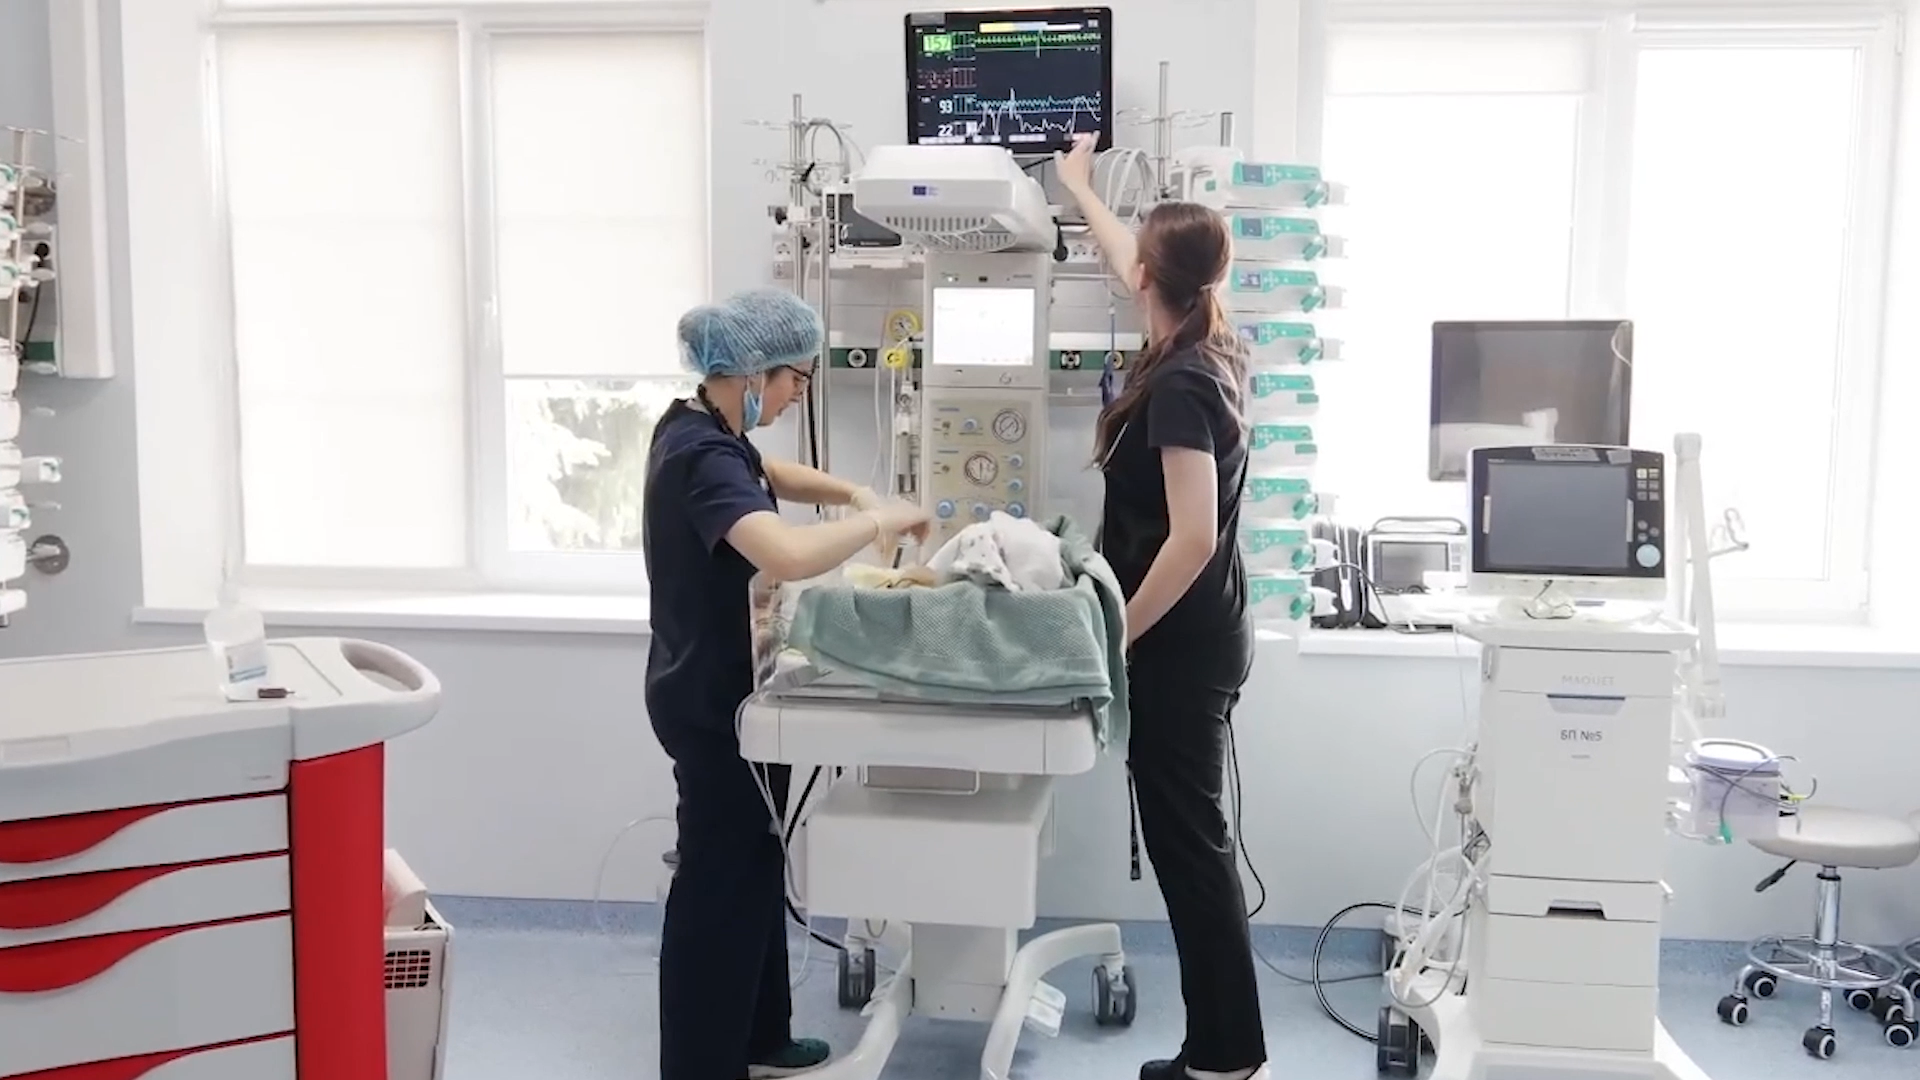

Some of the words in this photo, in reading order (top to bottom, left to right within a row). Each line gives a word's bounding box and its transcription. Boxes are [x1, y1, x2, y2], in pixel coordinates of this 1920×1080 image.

[926, 35, 950, 51] 157
[938, 99, 953, 115] 93
[937, 124, 953, 137] 22
[1561, 674, 1615, 686] MAQUET
[1560, 729, 1577, 741] БП
[1580, 730, 1603, 742] №5
